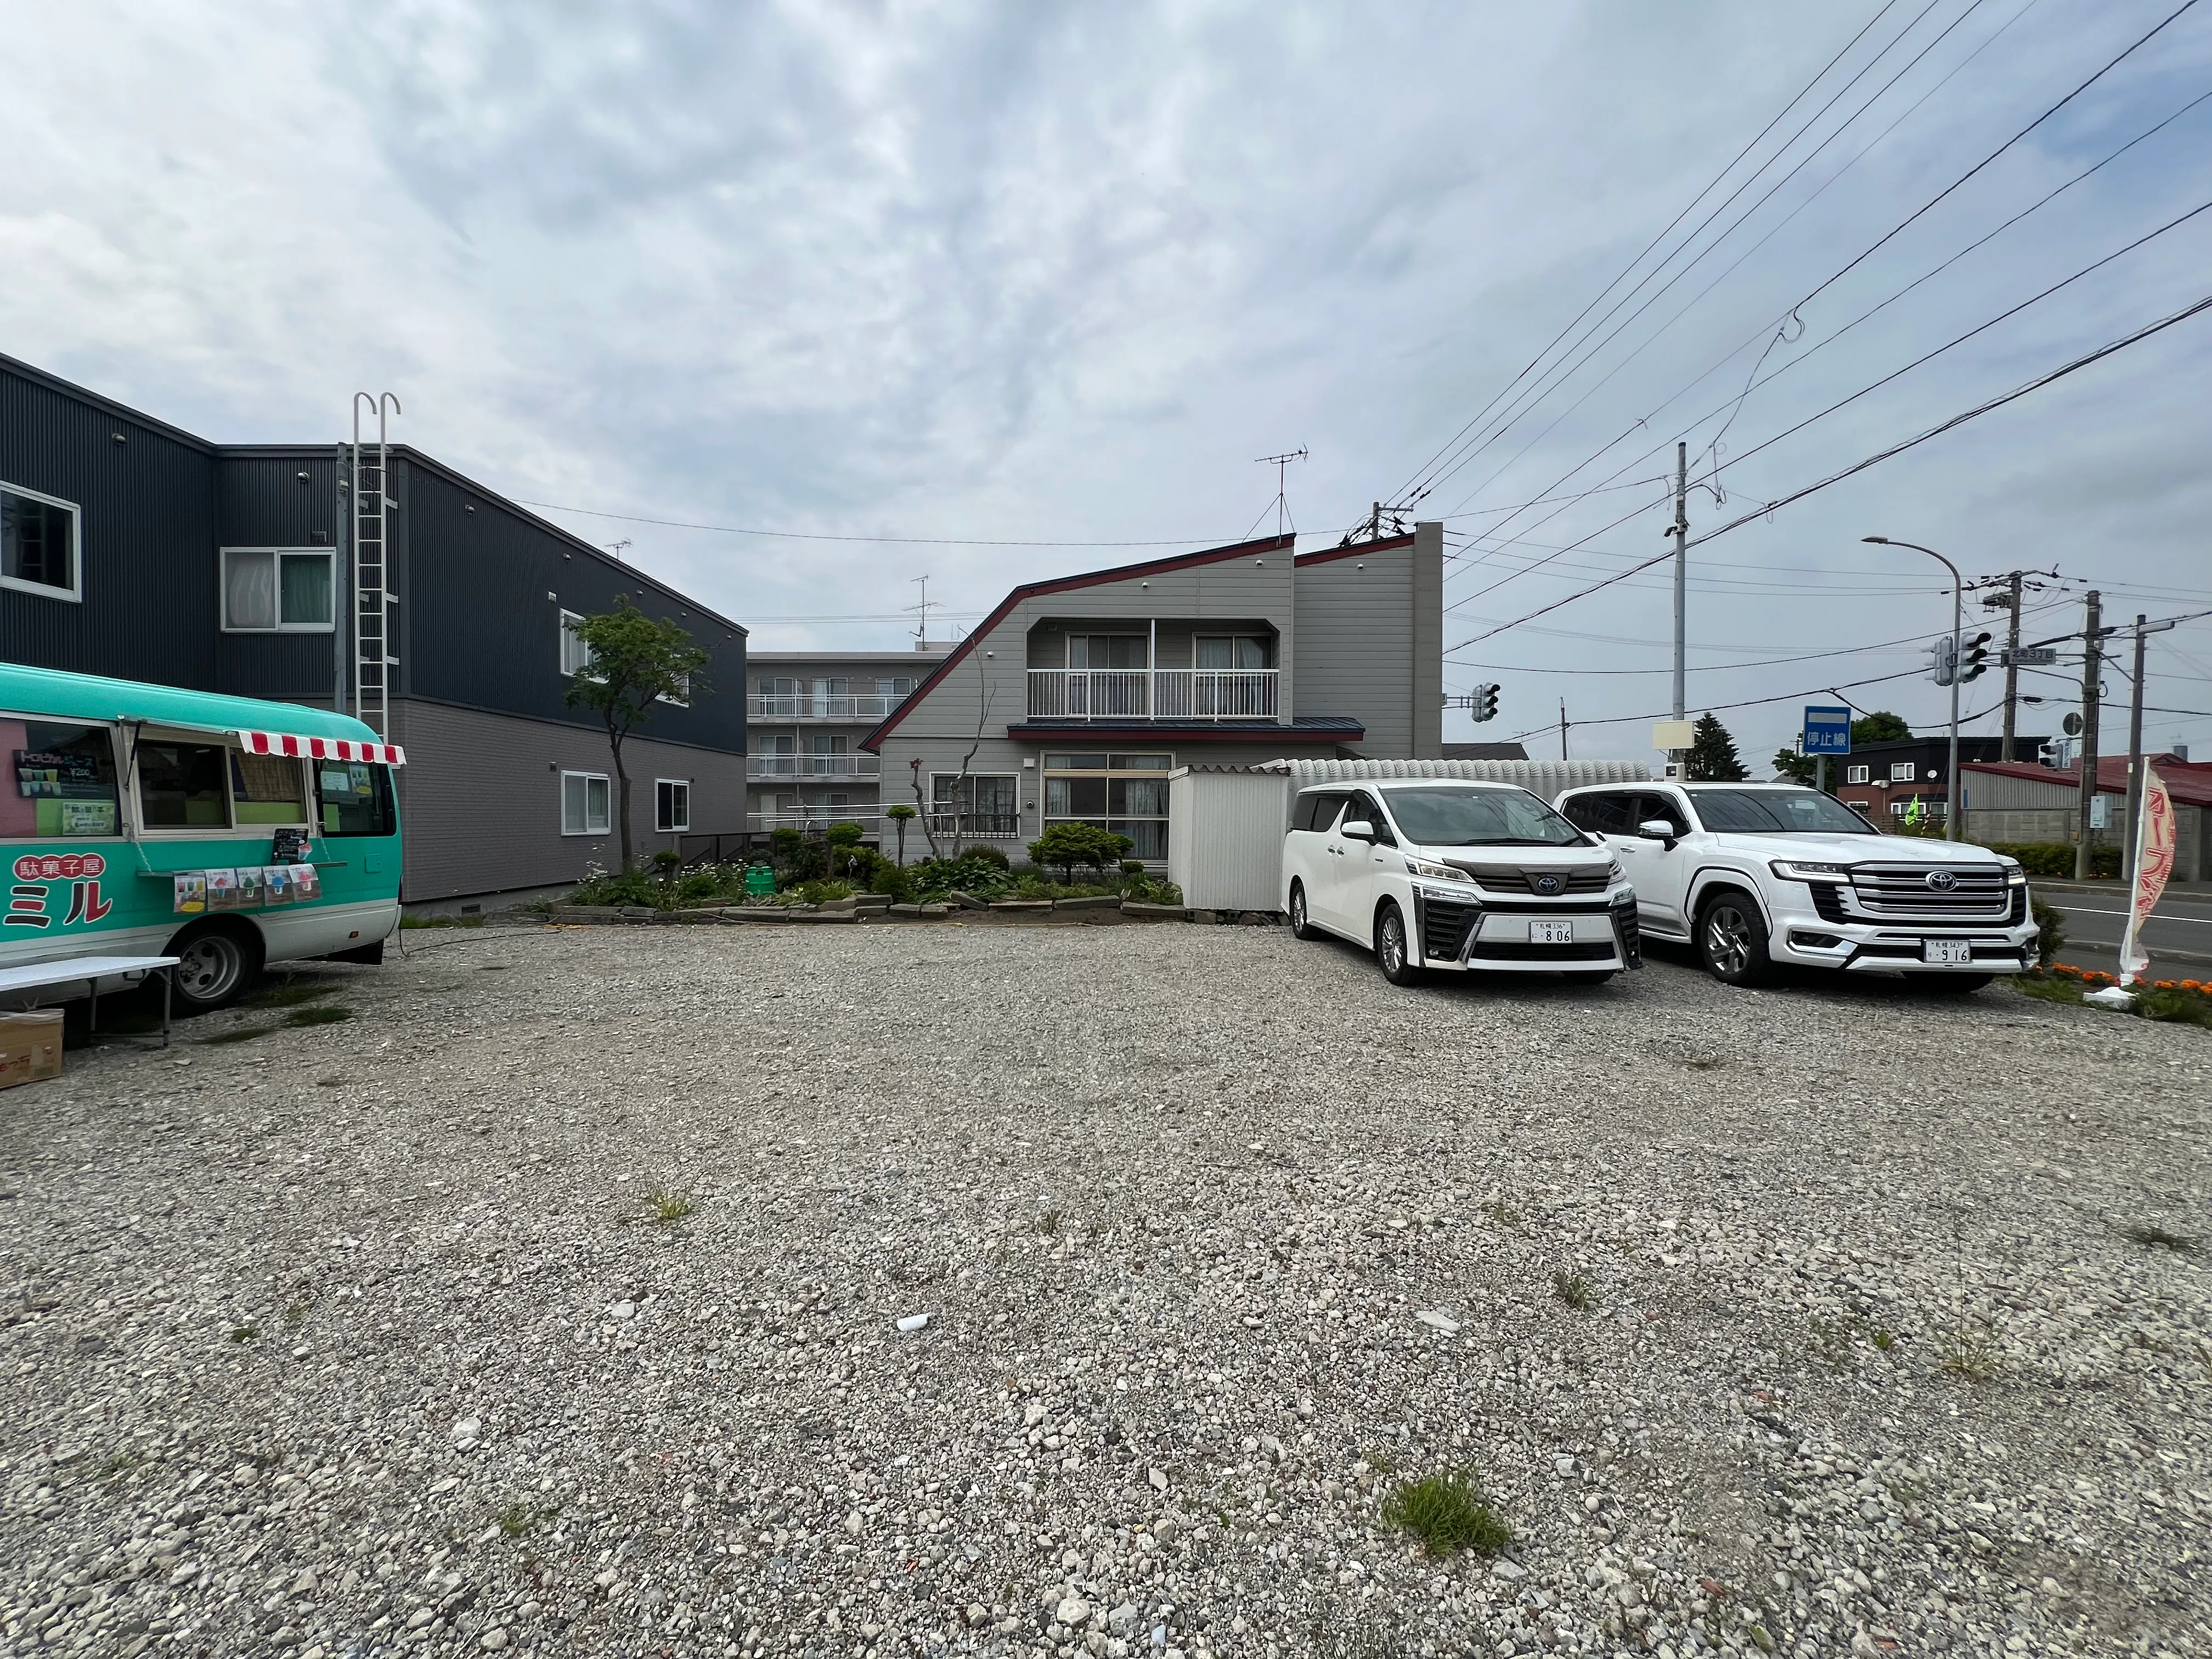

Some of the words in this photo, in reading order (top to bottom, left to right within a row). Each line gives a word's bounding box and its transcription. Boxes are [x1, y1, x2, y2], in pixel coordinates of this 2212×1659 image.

[1807, 731, 1846, 746] 停止線
[20, 858, 101, 877] 駄菓子屋
[3, 881, 113, 929] ミル
